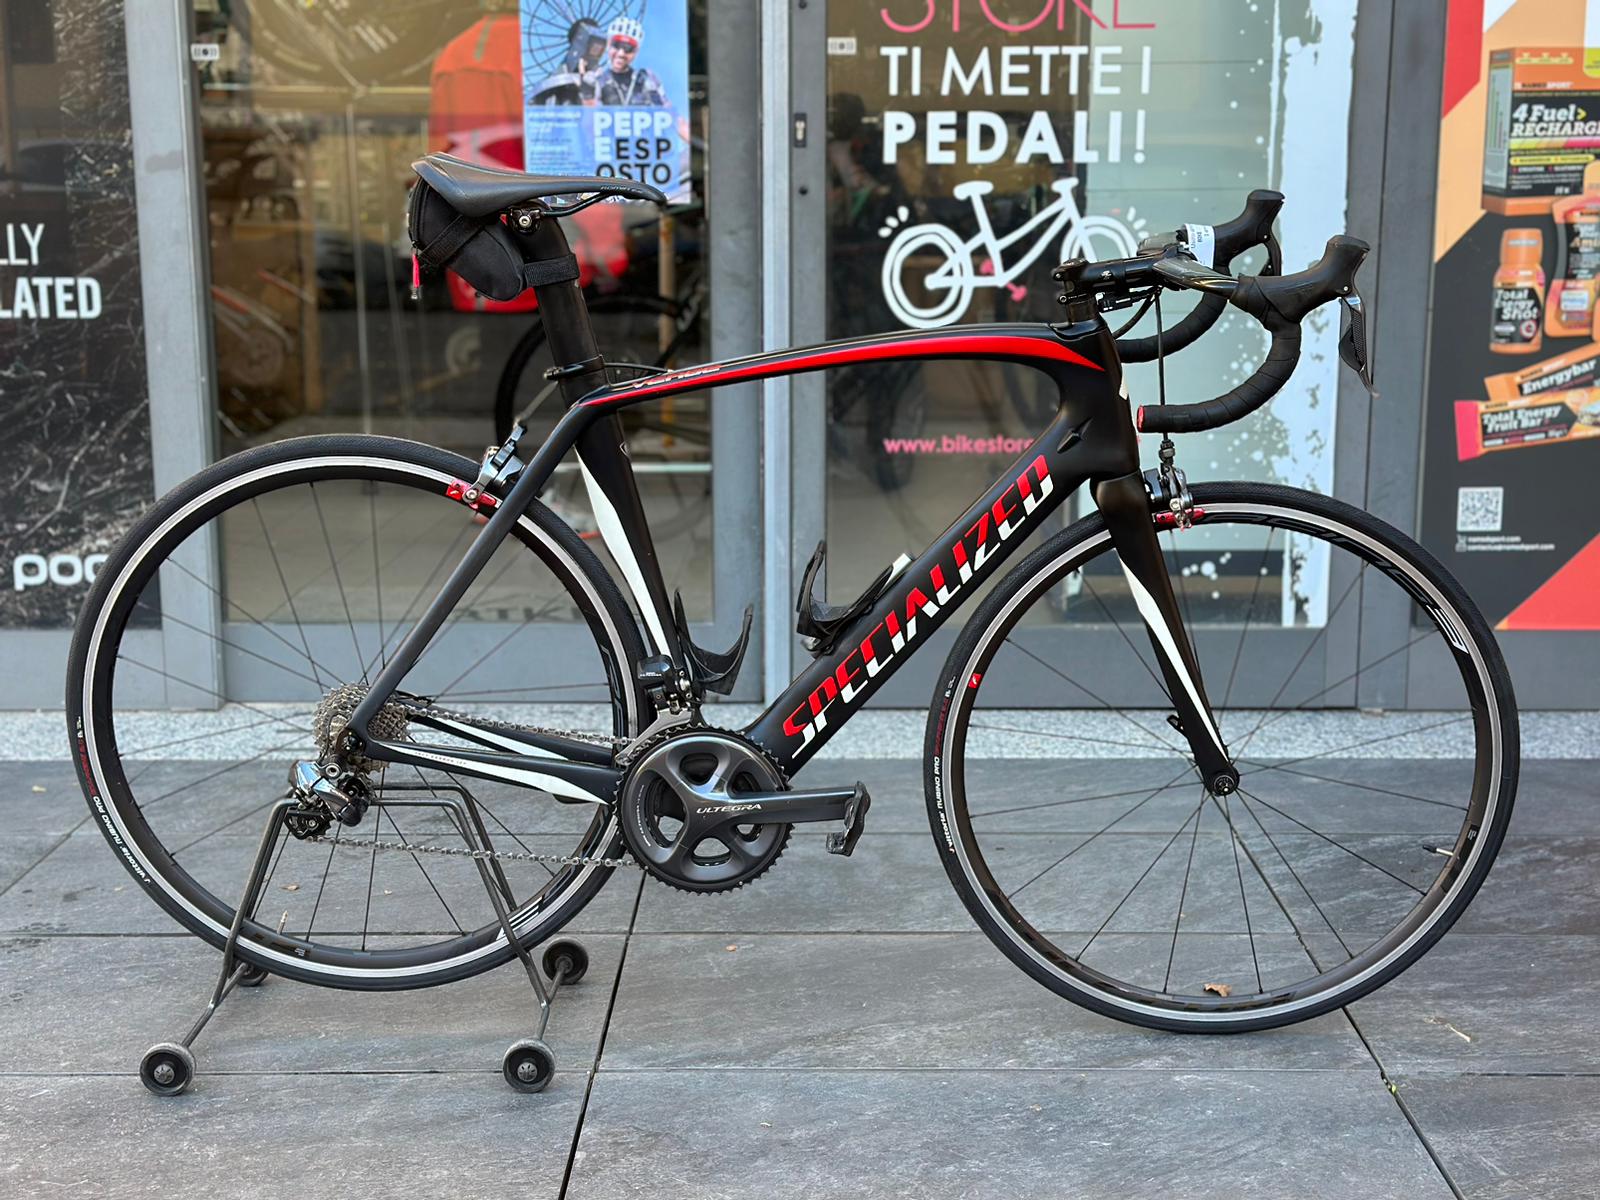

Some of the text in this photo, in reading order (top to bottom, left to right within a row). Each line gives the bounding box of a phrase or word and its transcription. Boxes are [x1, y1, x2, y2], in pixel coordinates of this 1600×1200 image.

[880, 46, 1151, 96] TI METTE I
[593, 111, 673, 137] PEPP
[1529, 103, 1577, 122] Fuel
[882, 109, 1146, 164] PEDALI!
[1511, 121, 1600, 137] RECHARG
[1522, 359, 1597, 395] Energybar
[783, 454, 1054, 759] SPECIALIZED
[696, 803, 762, 815] ULTEGRA
